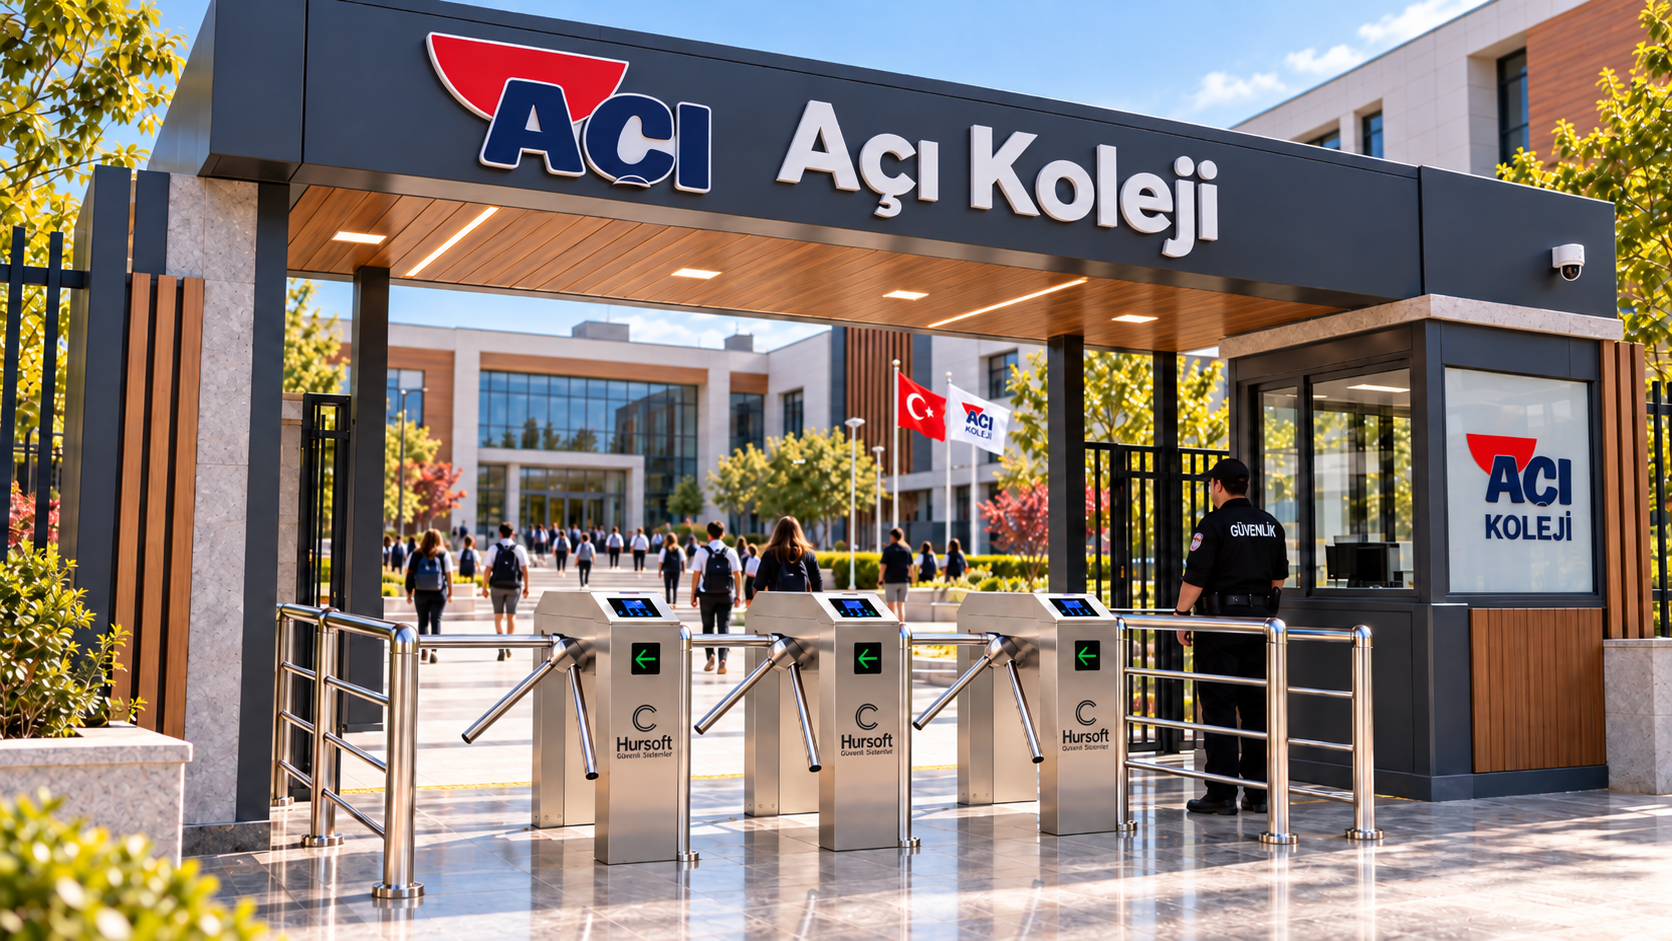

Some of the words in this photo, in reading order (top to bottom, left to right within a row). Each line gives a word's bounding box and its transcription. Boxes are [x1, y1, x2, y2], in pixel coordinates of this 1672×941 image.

[776, 100, 939, 218] Açı
[970, 124, 1219, 258] Koleji
[1230, 521, 1277, 538] GÜVENLİK
[1485, 511, 1572, 541] KOLEJİ
[616, 735, 673, 752] Hursoft
[841, 733, 893, 749] Hursoft
[1062, 728, 1109, 744] Hursoft
